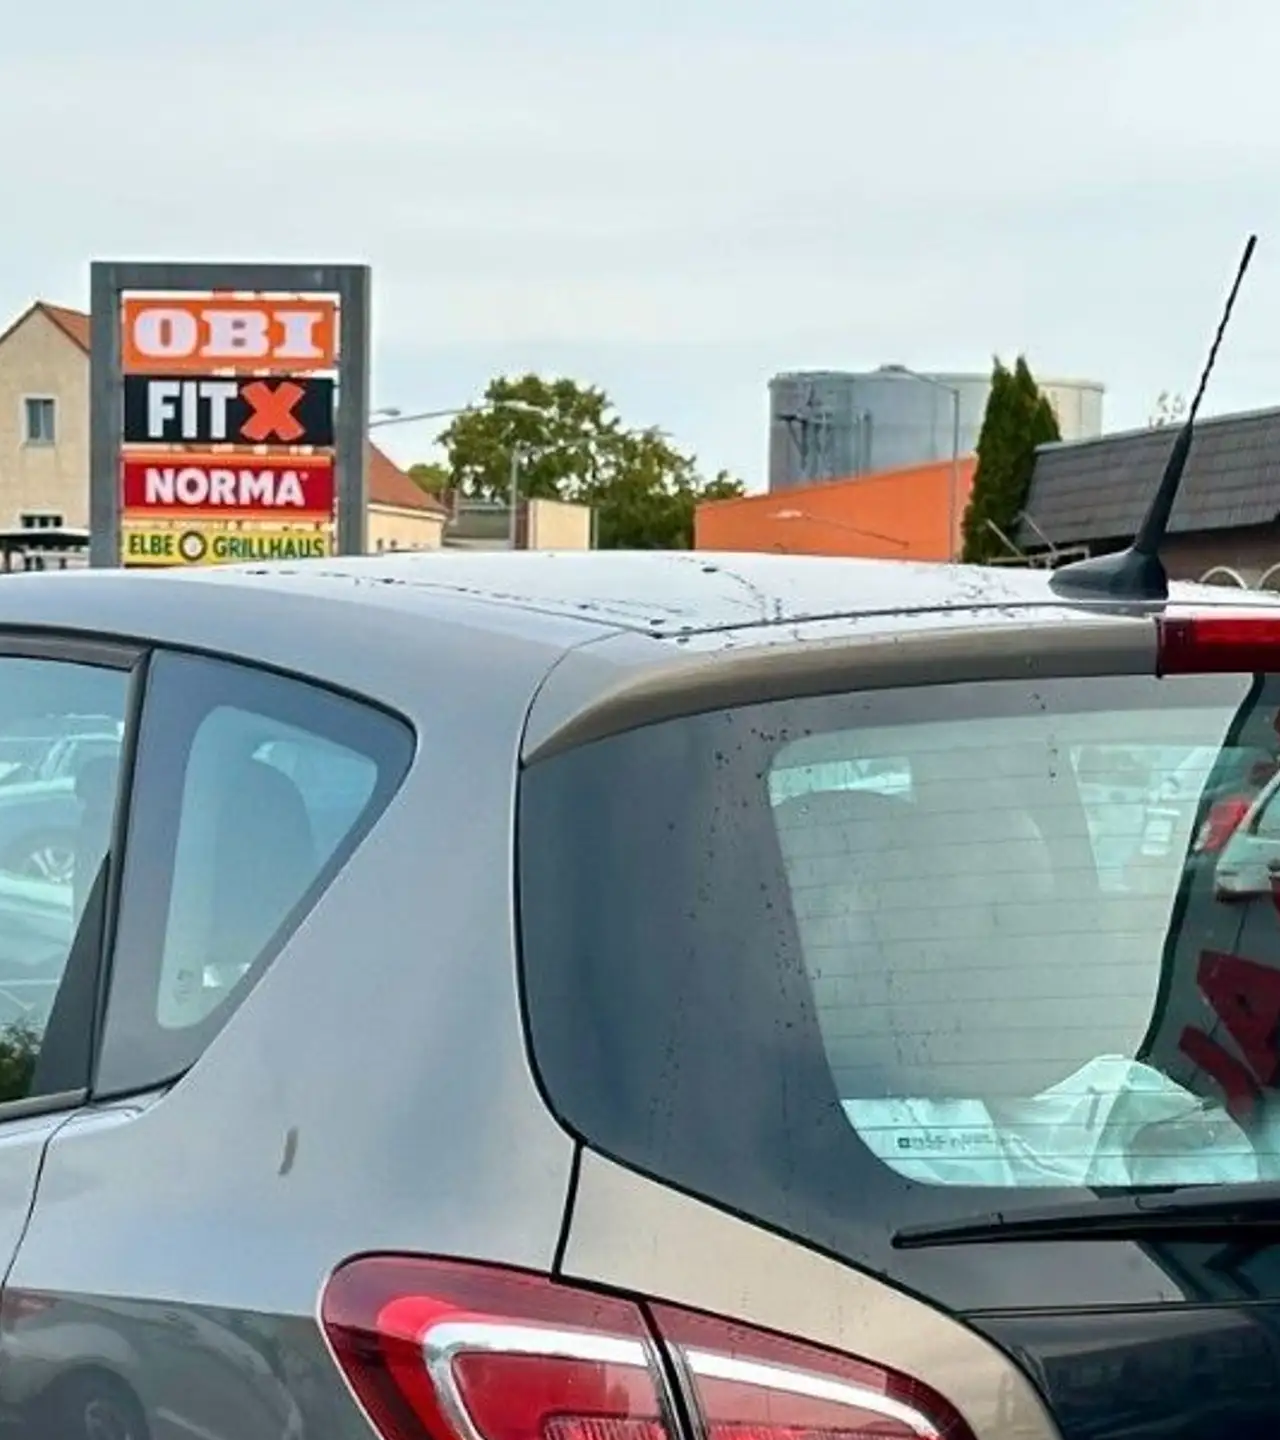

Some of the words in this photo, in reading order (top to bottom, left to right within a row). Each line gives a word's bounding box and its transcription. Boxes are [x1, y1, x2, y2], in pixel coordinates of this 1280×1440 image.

[133, 308, 324, 358] OBI
[144, 467, 306, 507] NORMA
[128, 533, 174, 556] ELBE
[213, 535, 325, 558] GRILLHAUS
